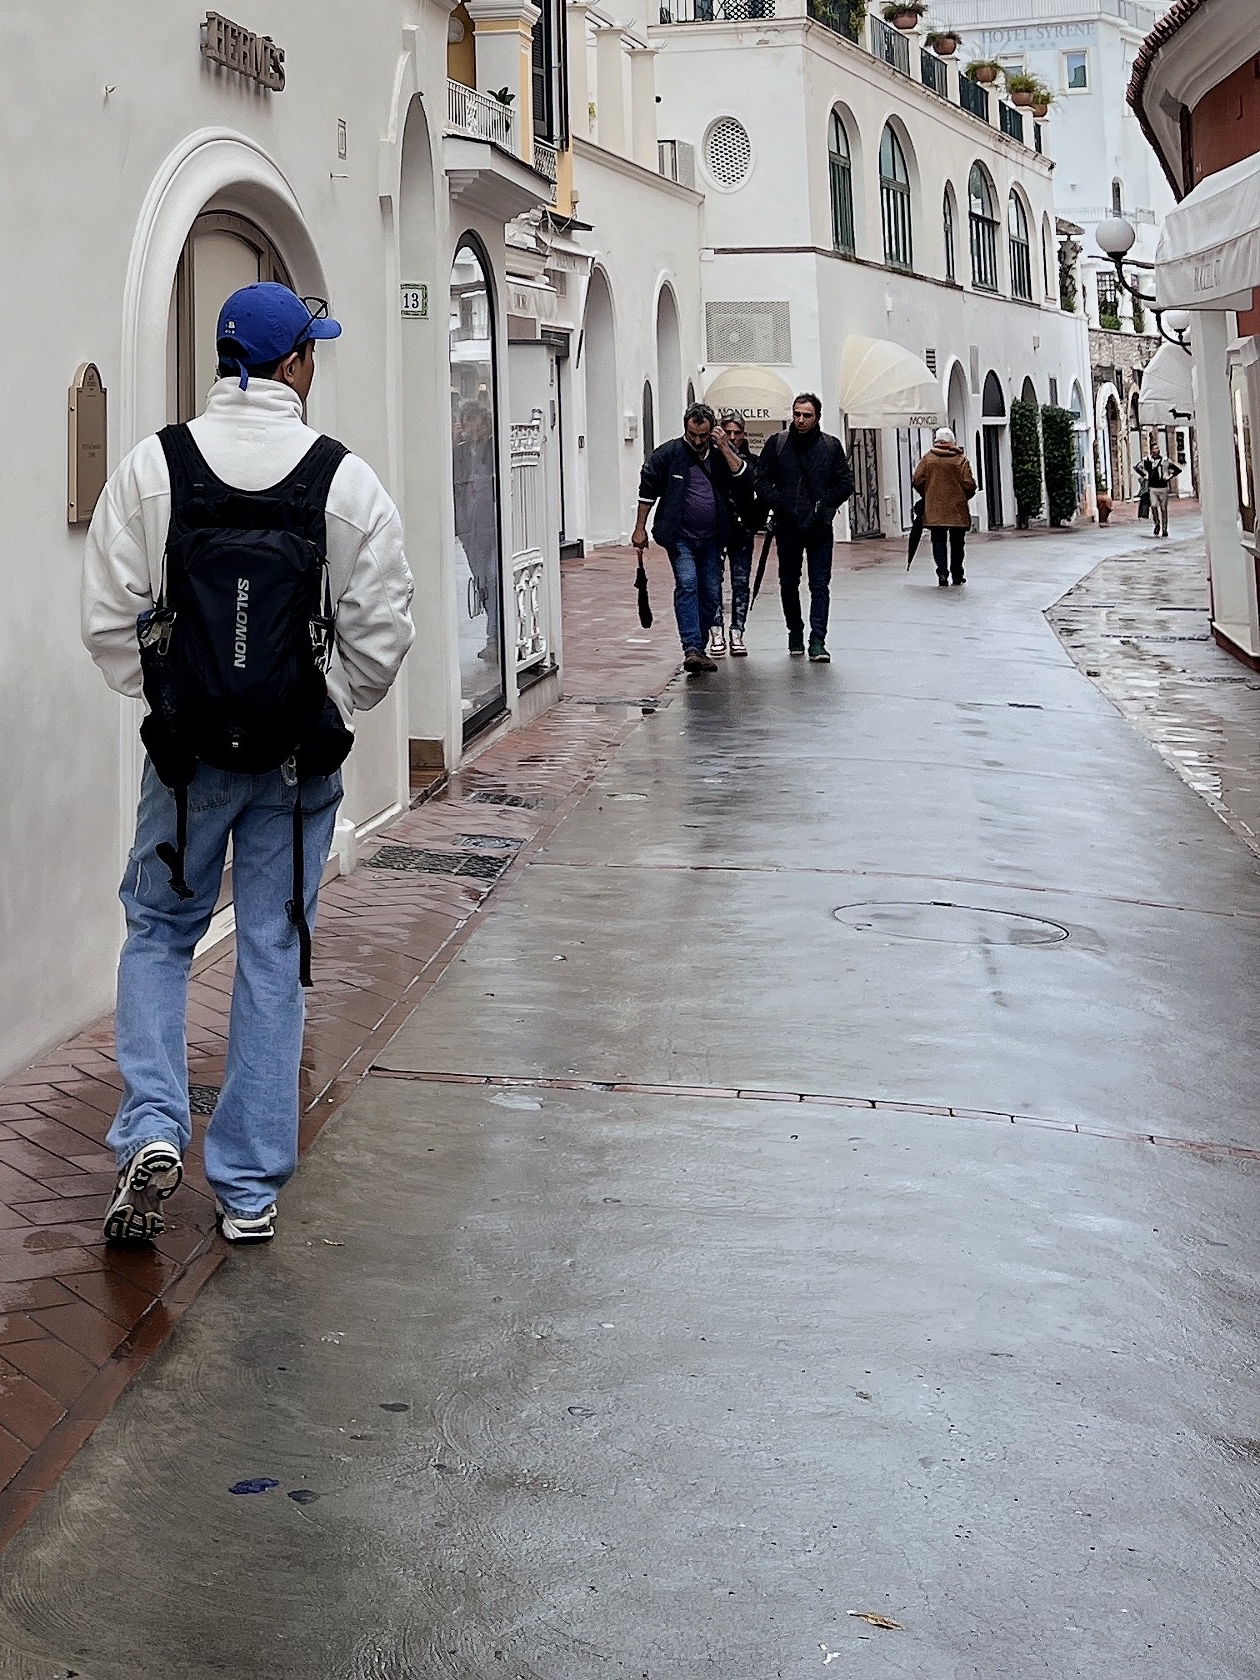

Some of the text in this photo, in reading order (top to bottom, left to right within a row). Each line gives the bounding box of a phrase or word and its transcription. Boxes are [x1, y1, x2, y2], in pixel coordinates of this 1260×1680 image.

[980, 22, 1094, 44] HOTEL SYRENE
[403, 292, 419, 309] 13
[234, 578, 249, 669] SALOMON
